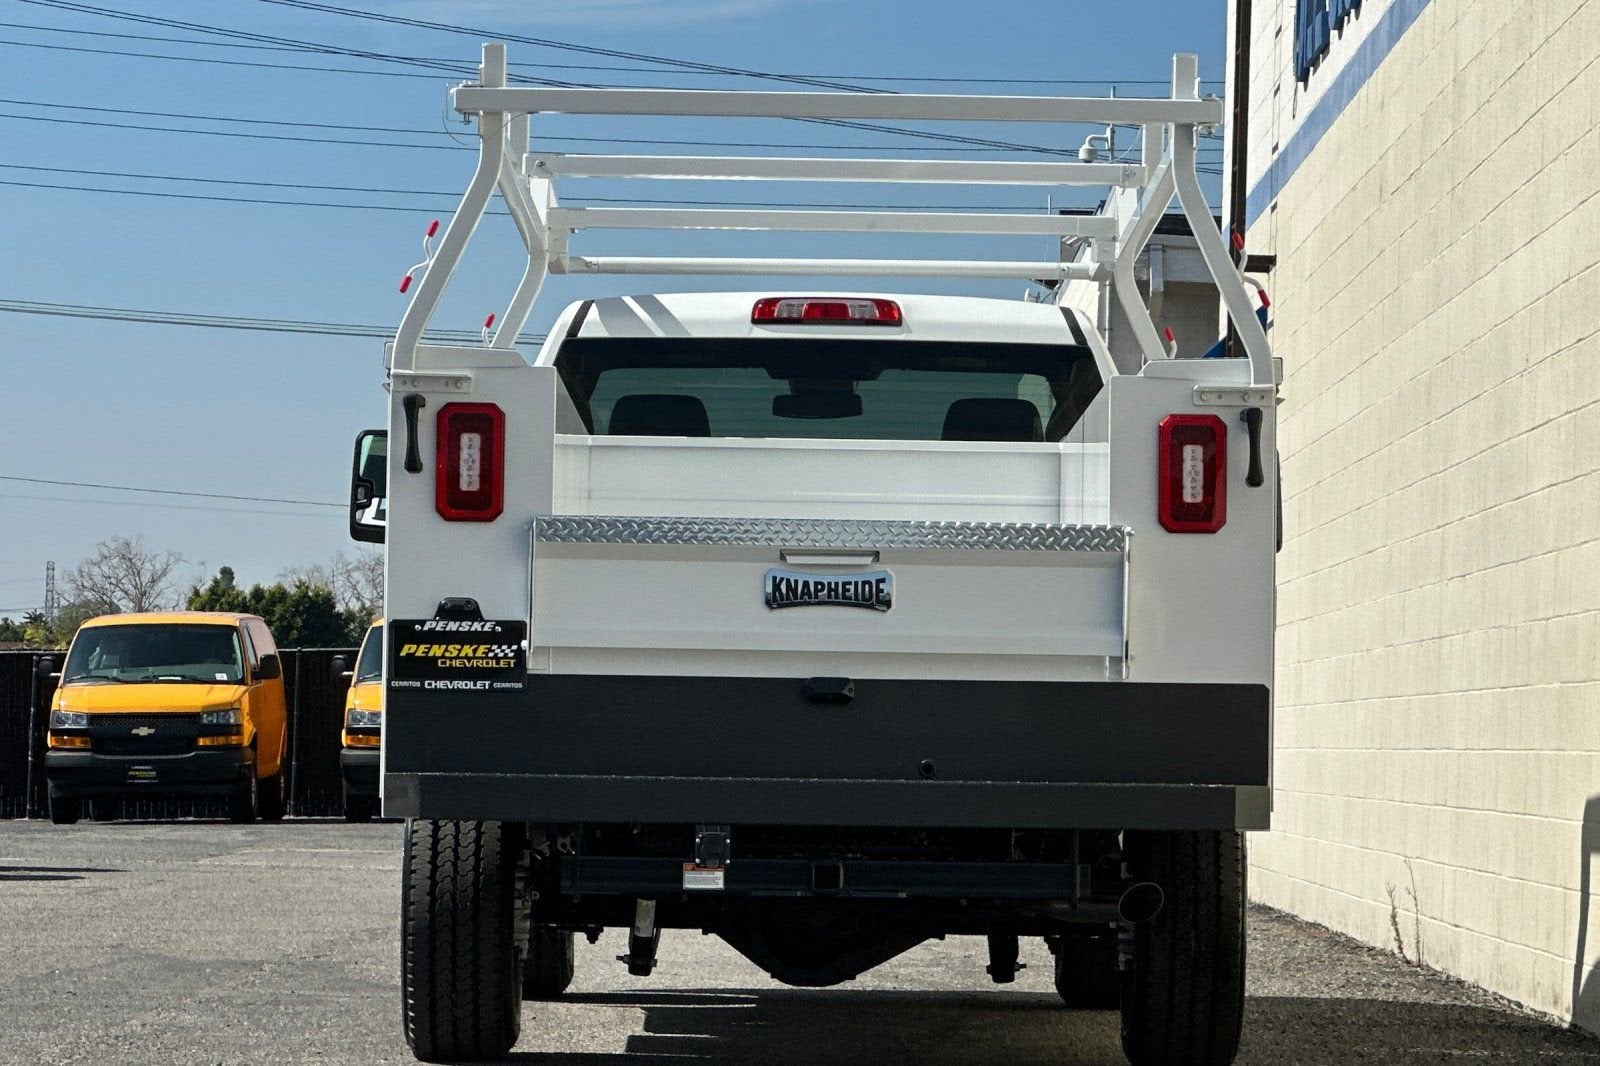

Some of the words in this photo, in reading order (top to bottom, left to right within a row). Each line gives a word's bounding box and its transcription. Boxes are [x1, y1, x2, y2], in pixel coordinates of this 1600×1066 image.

[771, 575, 886, 603] KNAPHEIDE
[422, 620, 496, 632] PENSKE
[399, 644, 491, 657] PENSKE
[437, 658, 517, 668] CHEVROLET
[424, 680, 491, 690] CHEVROLET
